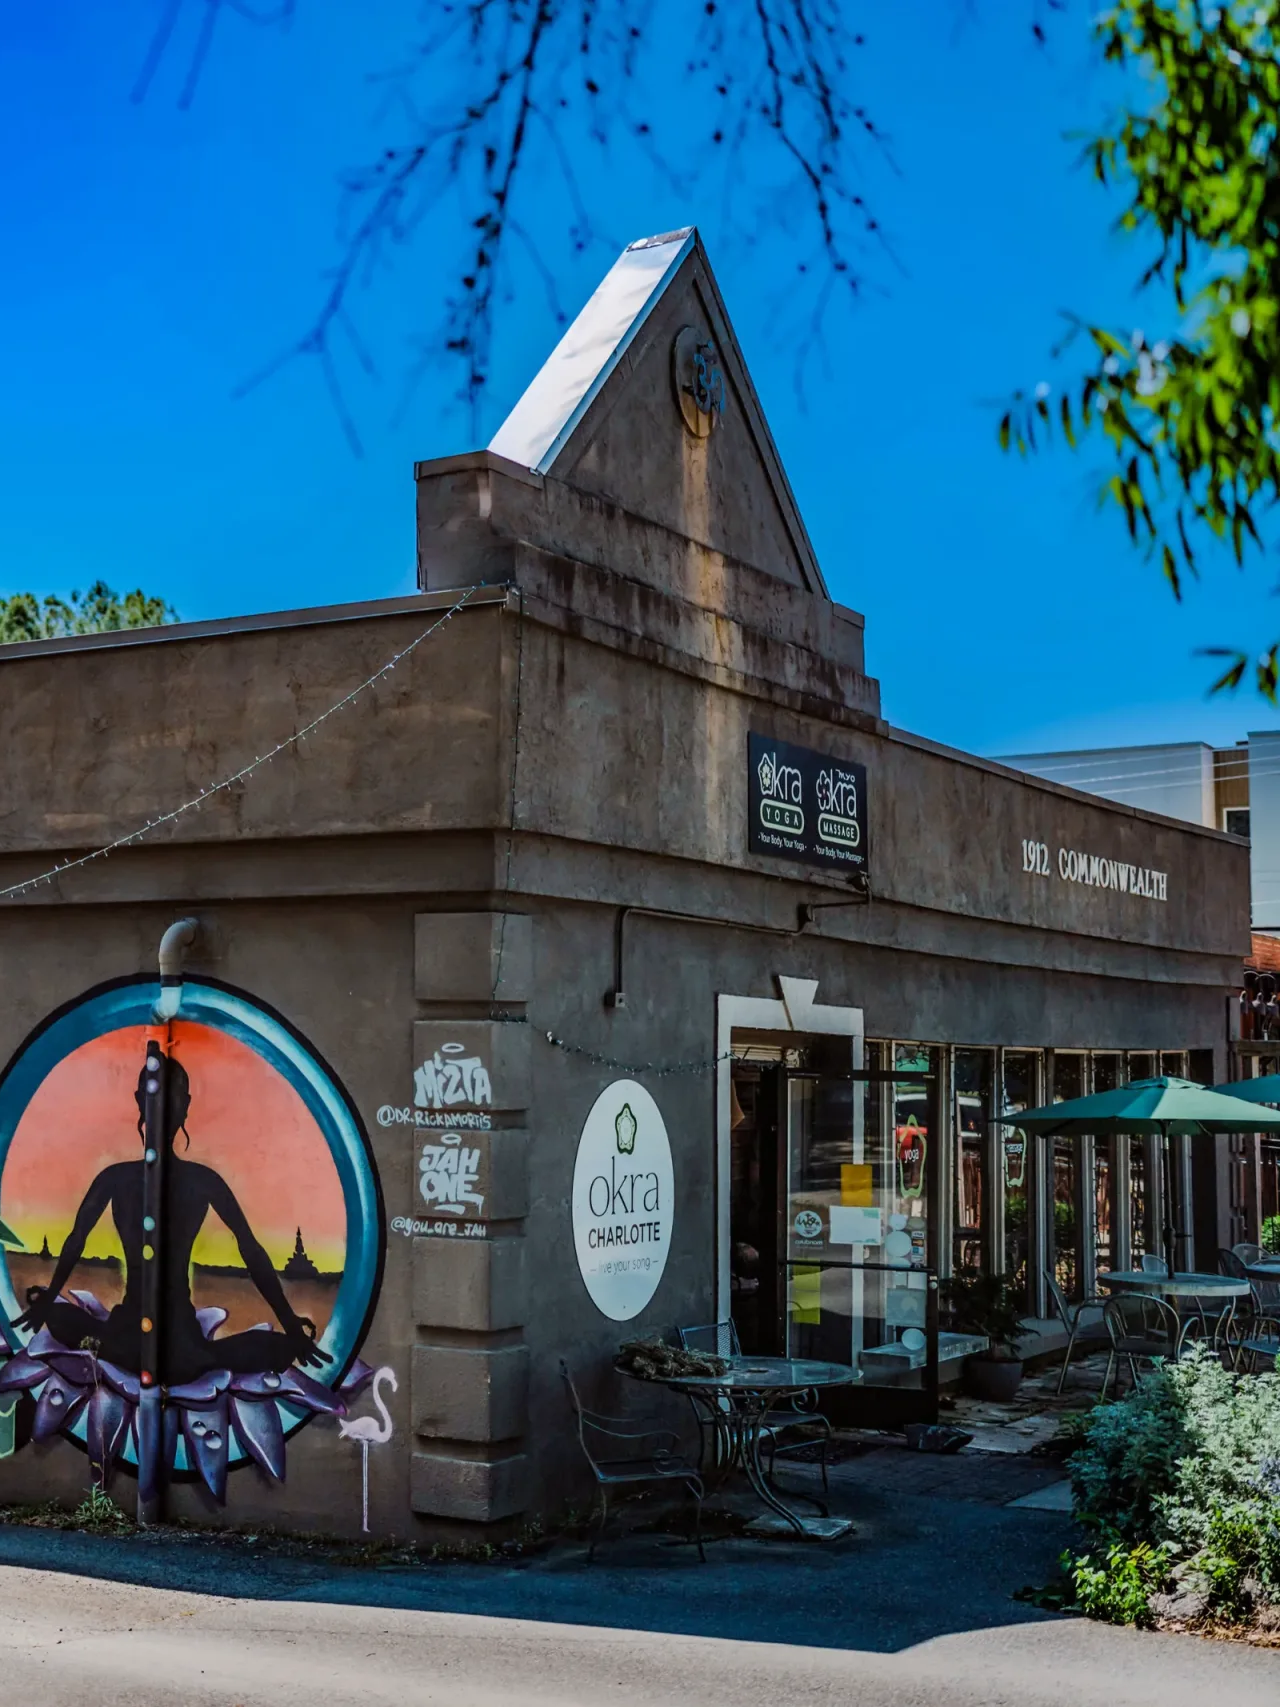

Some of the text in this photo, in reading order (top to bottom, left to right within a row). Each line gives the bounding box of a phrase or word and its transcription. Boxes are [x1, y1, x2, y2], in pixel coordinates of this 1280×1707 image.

[766, 806, 799, 827] YOGA
[823, 821, 855, 839] MASSAGE
[760, 832, 770, 843] Your
[783, 837, 793, 848] Your
[793, 839, 805, 852] Yoga
[815, 844, 825, 855] Your
[836, 849, 846, 858] Your
[846, 851, 863, 864] Massage
[1021, 839, 1168, 901] 1912 COMMONWEALTH
[419, 1145, 480, 1174] JAH
[904, 1148, 920, 1163] yoga
[419, 1170, 484, 1206] ONE
[589, 1156, 660, 1218] okra
[588, 1221, 661, 1249] CHARLOTTE
[614, 1260, 630, 1276] your
[633, 1257, 651, 1271] song
